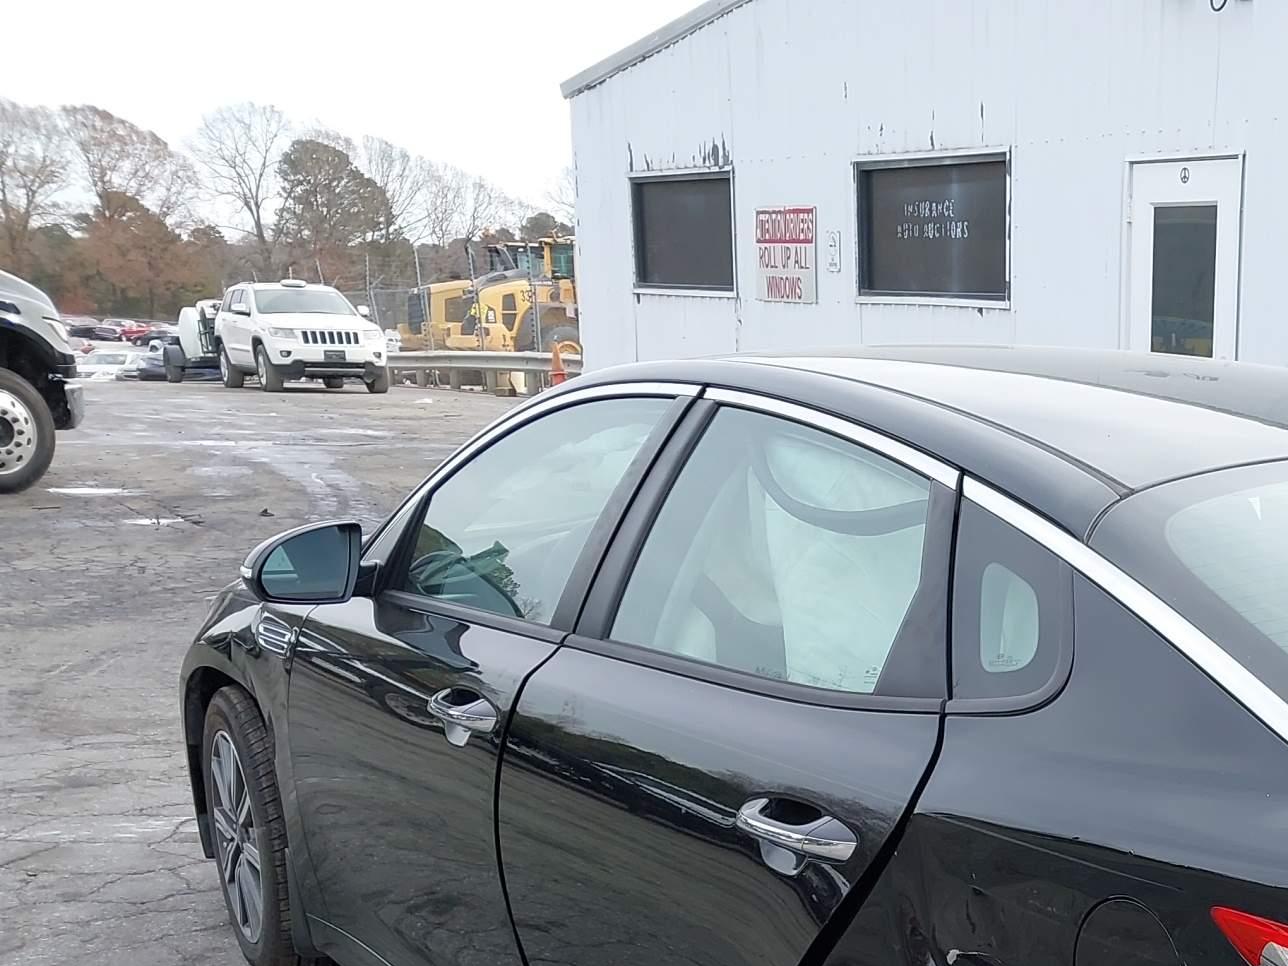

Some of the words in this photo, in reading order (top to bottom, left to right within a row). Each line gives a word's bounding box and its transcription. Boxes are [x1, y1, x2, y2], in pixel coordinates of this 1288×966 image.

[904, 199, 955, 217] INSURANCE
[756, 212, 783, 241] ATTENTION
[784, 211, 813, 241] DRIVERS
[897, 222, 919, 239] AUTO
[923, 221, 969, 239] AUCTIONS
[759, 246, 778, 268] ROLL
[781, 246, 792, 269] UP
[794, 246, 811, 270] ALL
[766, 275, 803, 300] WINDOWS
